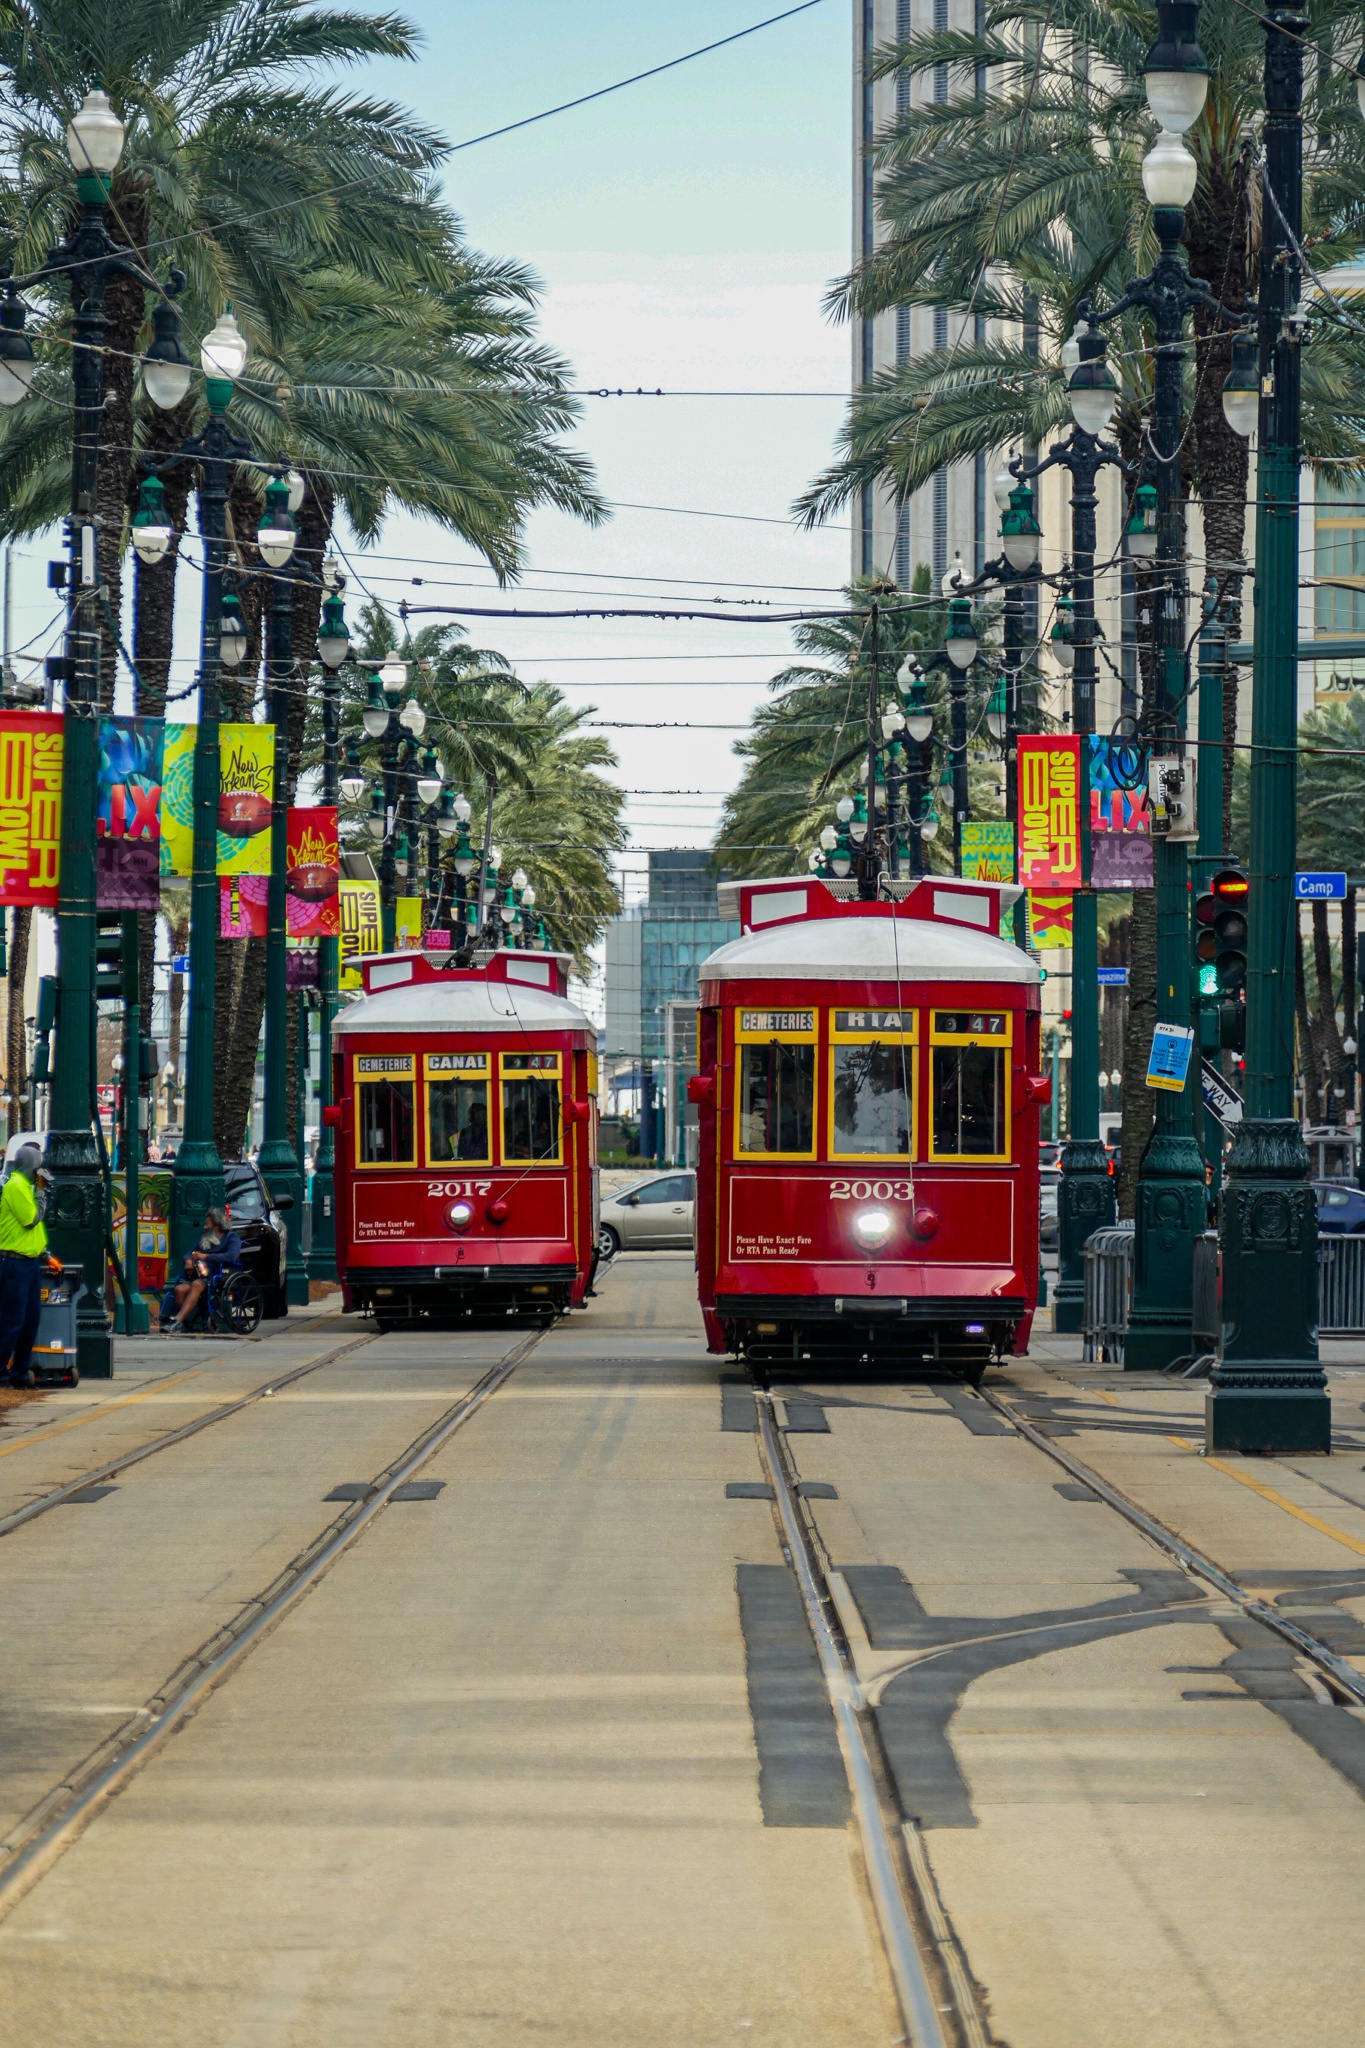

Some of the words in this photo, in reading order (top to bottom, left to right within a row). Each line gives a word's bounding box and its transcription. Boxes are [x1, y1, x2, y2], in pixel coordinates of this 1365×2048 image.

[228, 745, 259, 774] New
[0, 732, 32, 886] BOWL
[29, 733, 64, 888] SUPER
[97, 784, 162, 837] IX
[1023, 752, 1049, 873] BOWL
[1050, 751, 1076, 874] SUPER
[1090, 790, 1150, 831] LIX
[298, 826, 326, 853] New
[978, 859, 1002, 882] New
[1299, 878, 1333, 896] Camp
[340, 892, 359, 978] BOWL
[359, 892, 378, 956] SUPE
[742, 1013, 814, 1030] CEMETERIES
[848, 1012, 901, 1027] RTA
[360, 1057, 412, 1071] CEMETERIES
[429, 1055, 486, 1069] CANAL
[1207, 1084, 1231, 1108] WAY
[428, 1181, 492, 1197] 2017
[830, 1181, 914, 1200] 2003
[736, 1235, 756, 1244] Please
[757, 1236, 774, 1244] Have
[776, 1236, 795, 1245] Exact
[797, 1236, 812, 1245] Fare
[736, 1246, 745, 1255] Or
[746, 1246, 760, 1255] RTA
[762, 1247, 777, 1255] Pass
[779, 1247, 799, 1256] Ready
